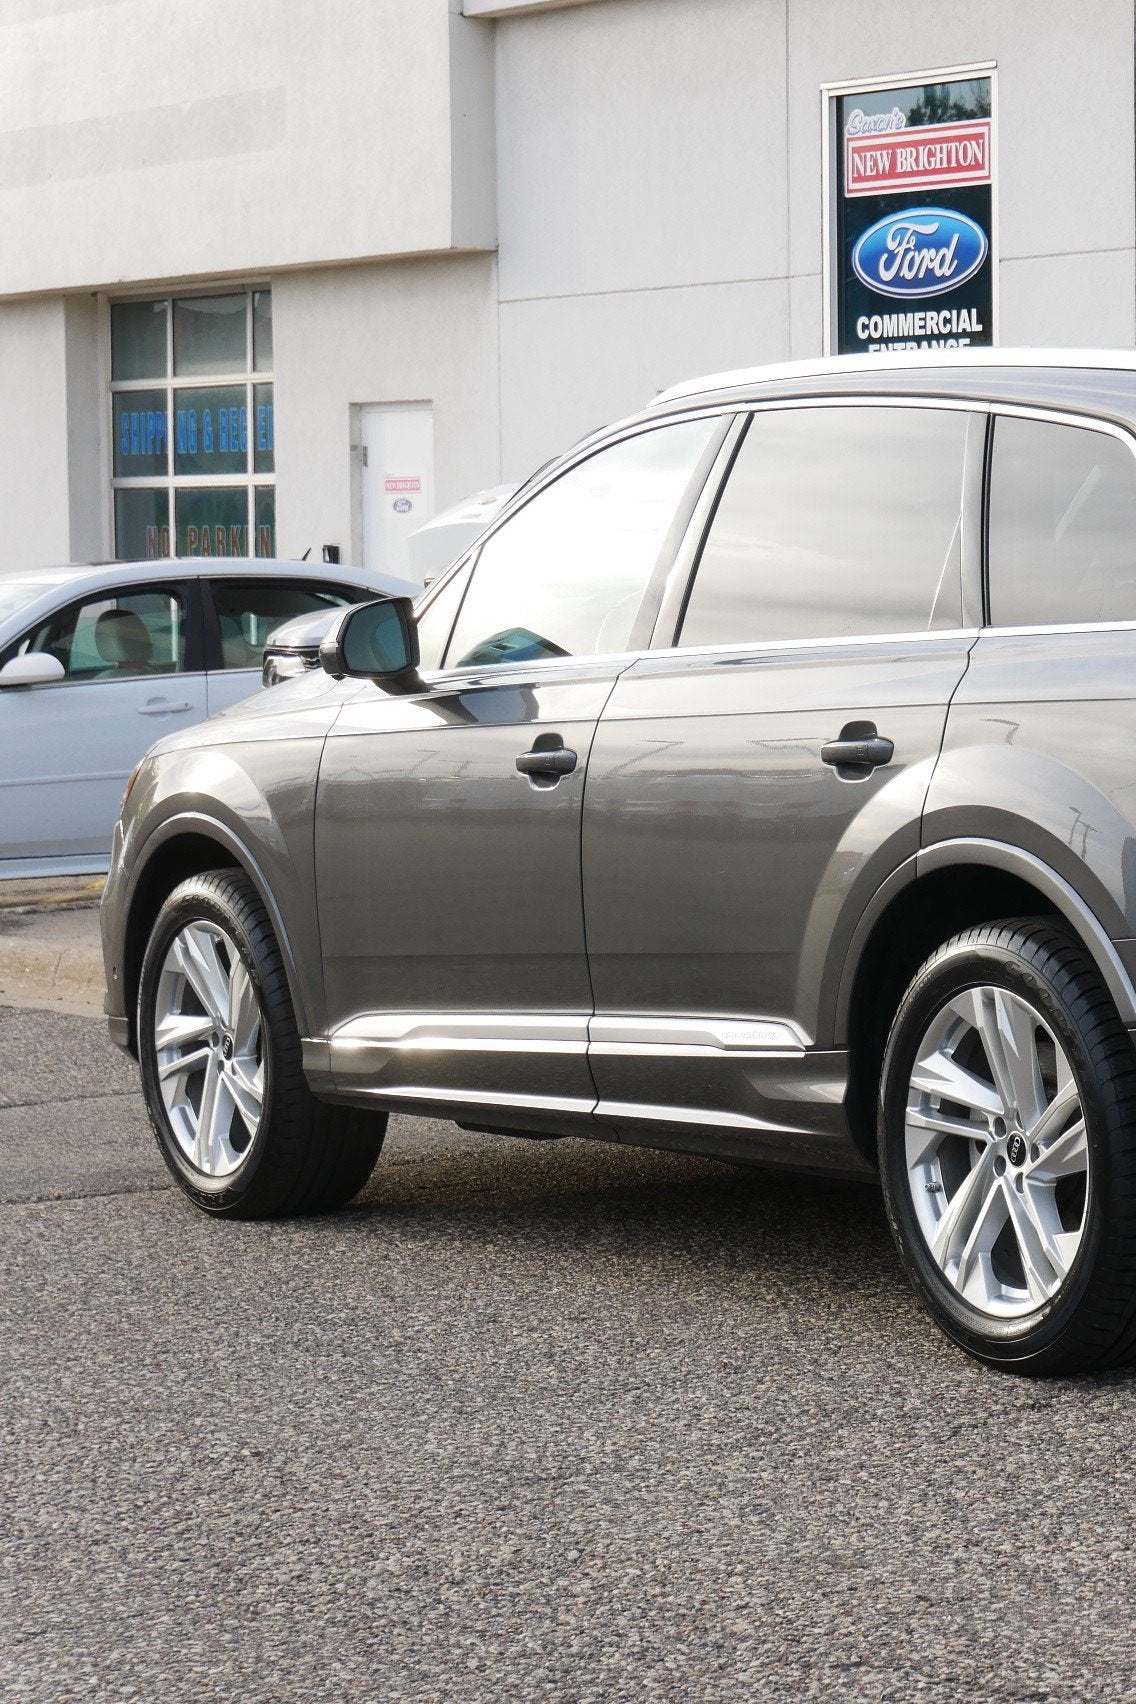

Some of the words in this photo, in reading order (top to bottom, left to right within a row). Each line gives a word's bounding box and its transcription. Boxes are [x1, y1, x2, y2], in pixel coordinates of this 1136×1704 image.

[846, 108, 905, 136] Saxon's
[853, 150, 893, 178] NEW
[896, 139, 984, 173] BRIGHTON
[878, 222, 960, 281] Ford
[857, 308, 983, 340] COMMERCIAL
[203, 408, 214, 453] &
[146, 525, 170, 558] NO
